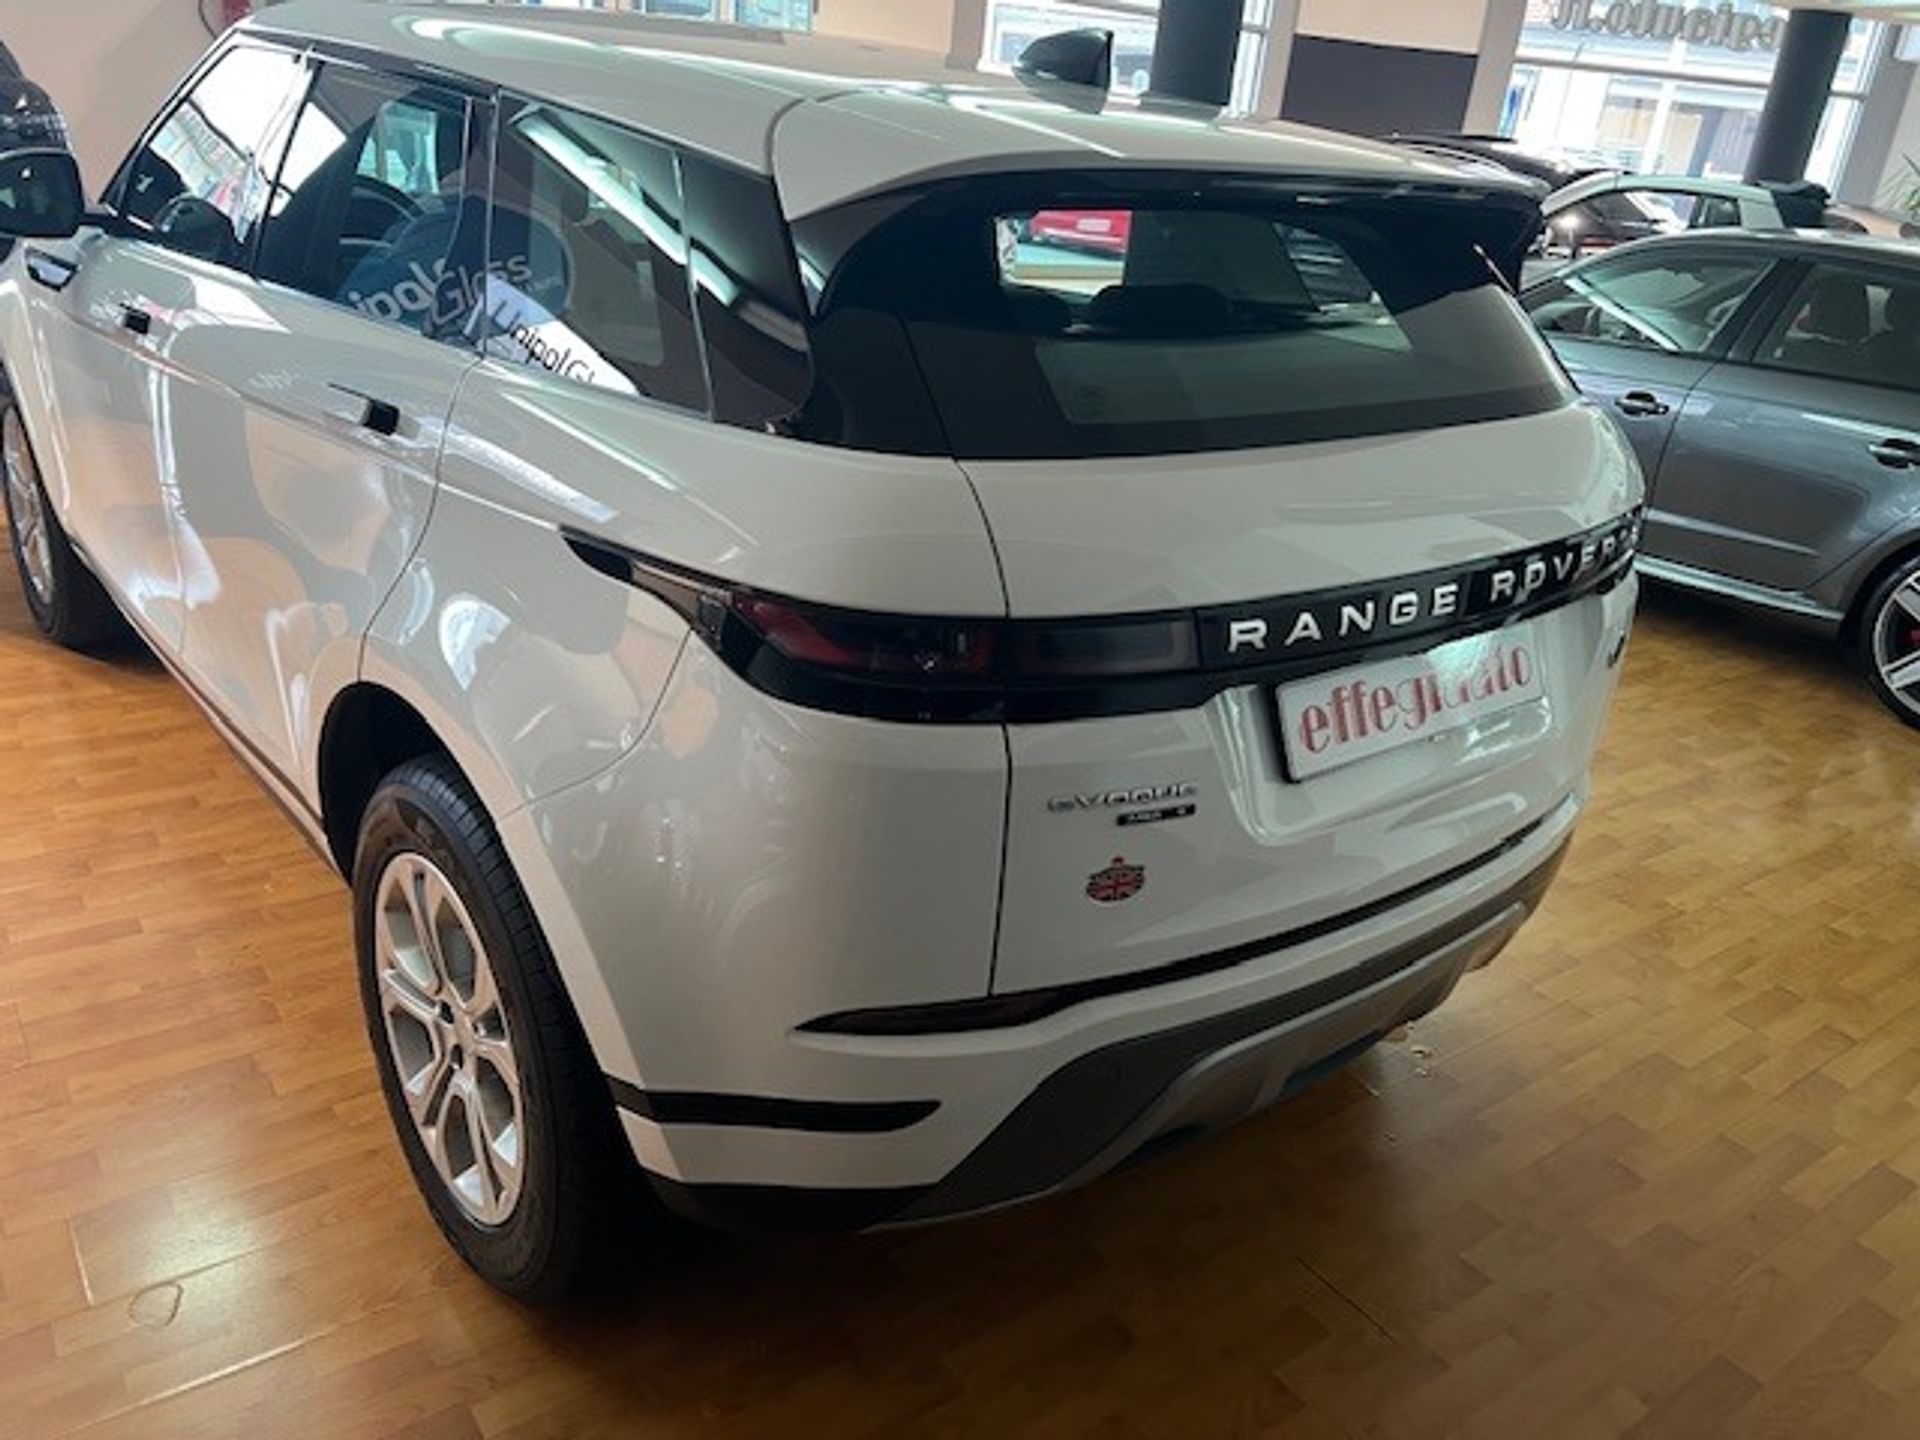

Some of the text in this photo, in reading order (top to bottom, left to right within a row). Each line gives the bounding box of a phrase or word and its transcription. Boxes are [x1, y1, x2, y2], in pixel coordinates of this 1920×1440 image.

[1227, 536, 1617, 653] RANGE ROVER
[1301, 645, 1533, 754] effegiauto
